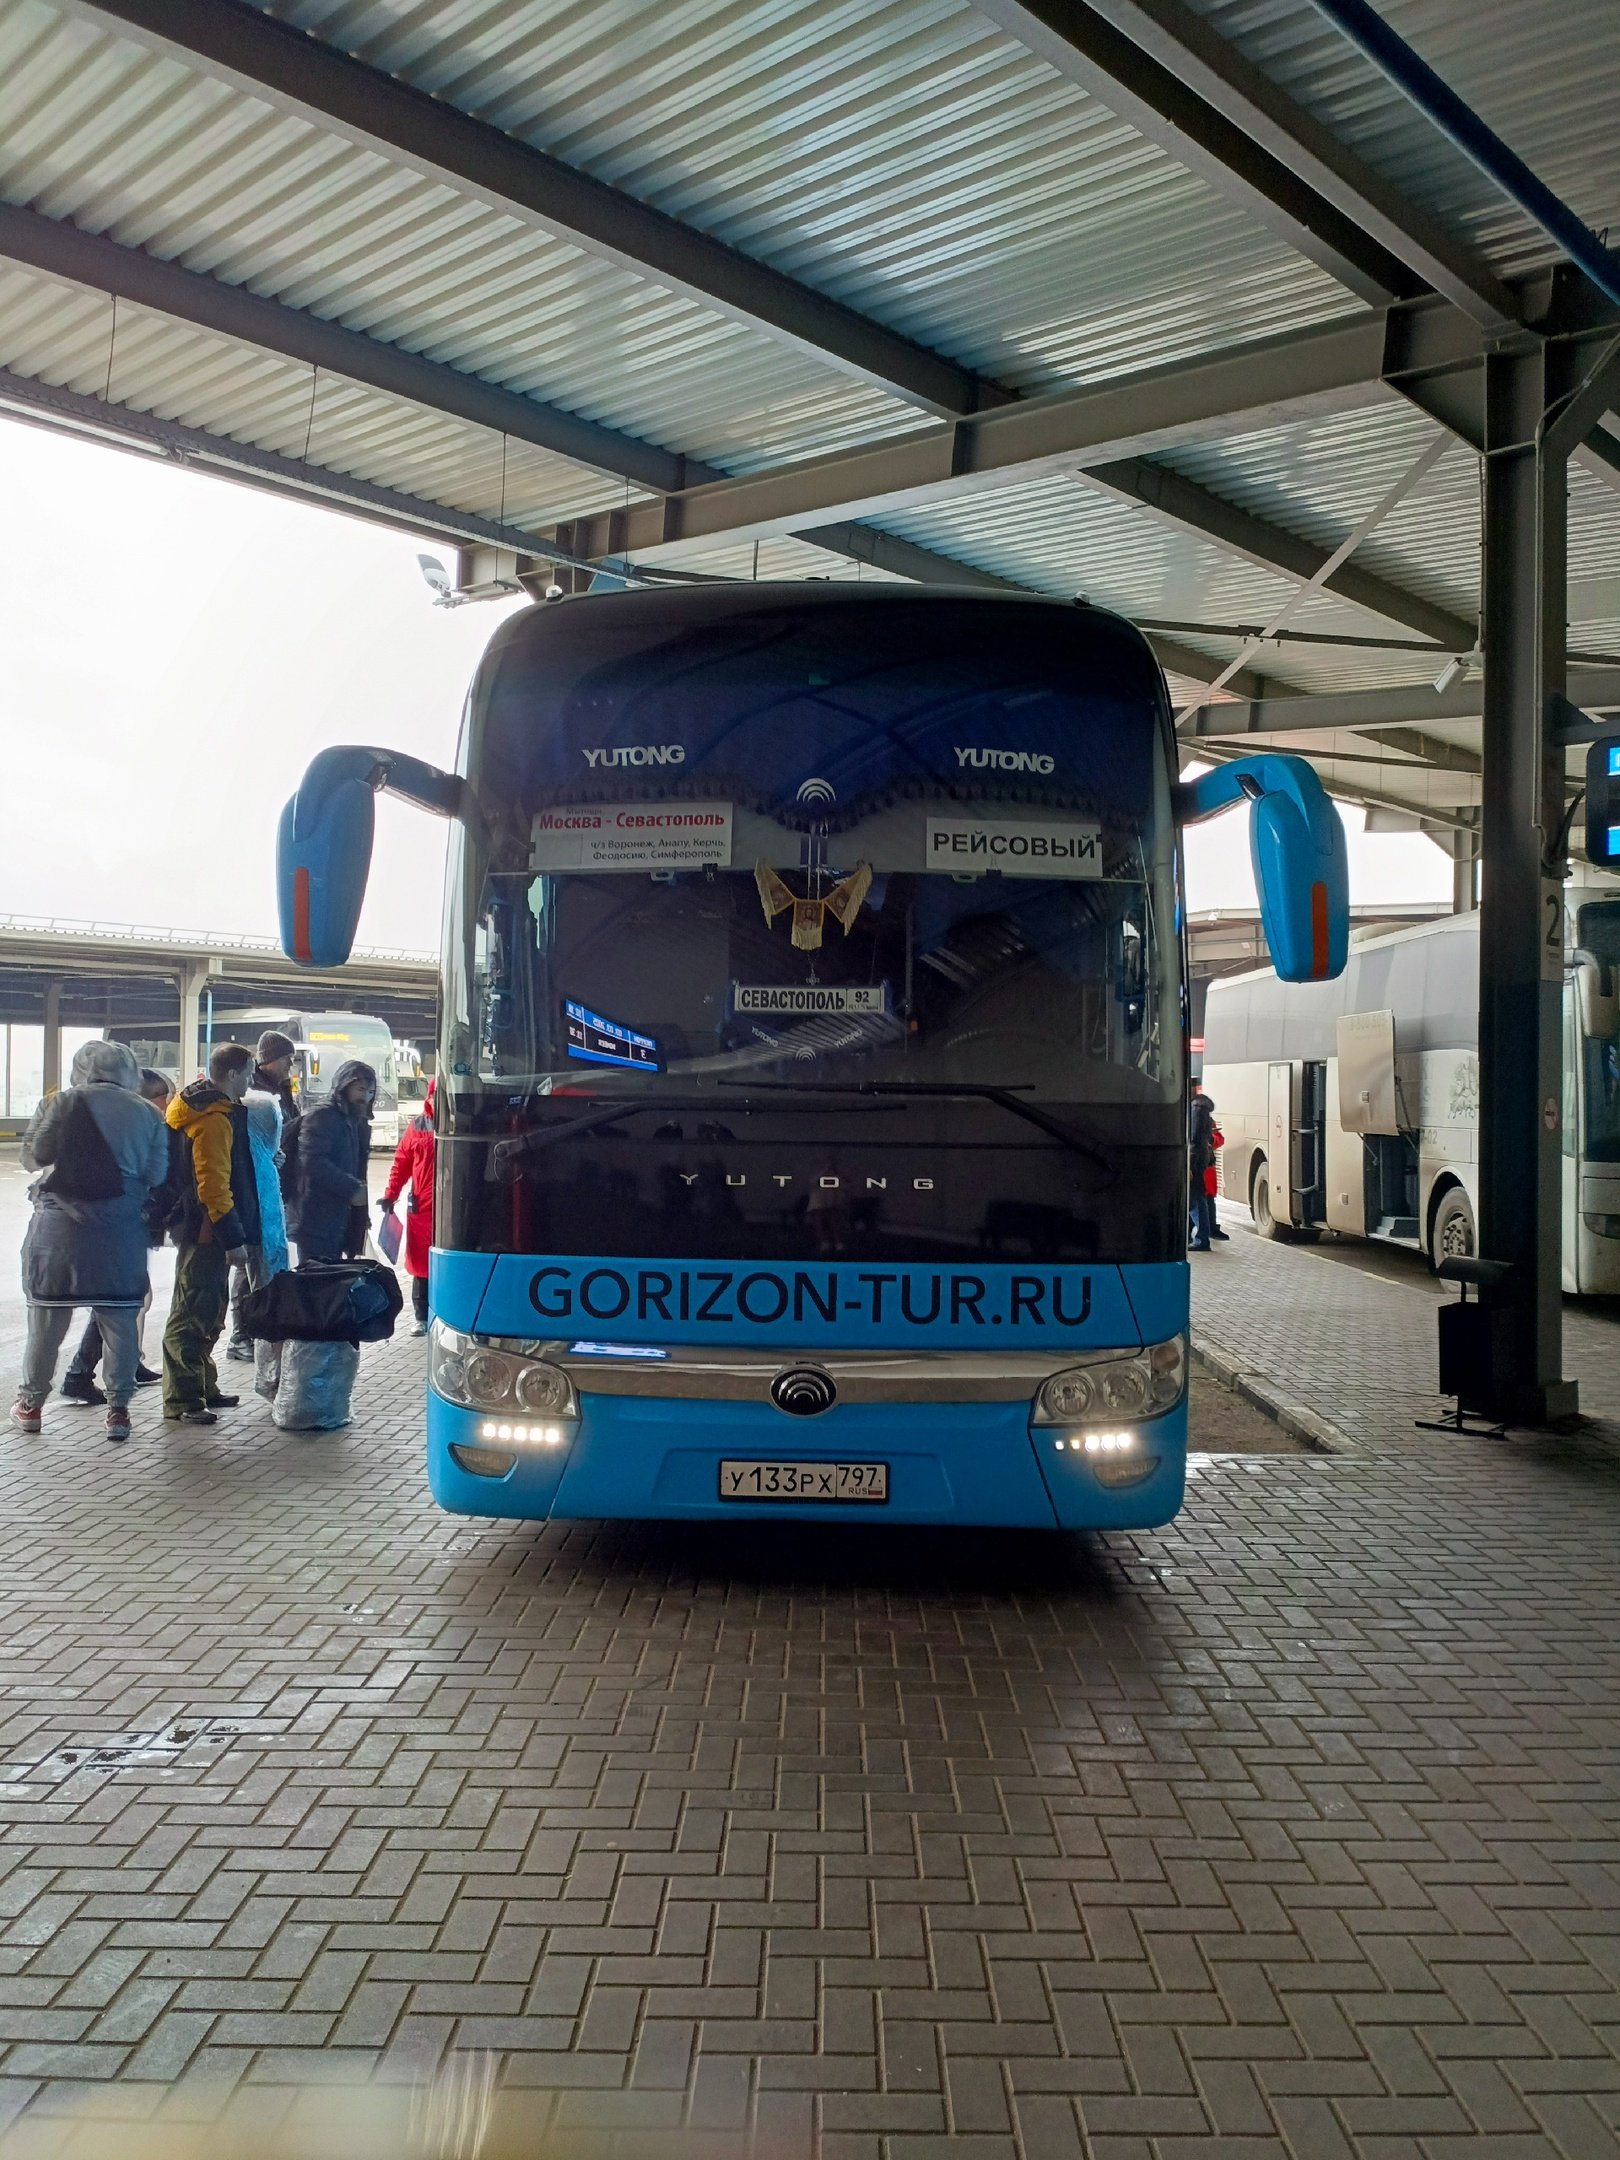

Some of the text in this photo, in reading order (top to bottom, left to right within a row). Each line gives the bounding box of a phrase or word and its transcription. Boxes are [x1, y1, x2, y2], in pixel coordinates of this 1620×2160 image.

[582, 745, 686, 768] YUTONG
[953, 746, 1055, 775] YUTONG
[539, 813, 602, 831] Москва
[616, 811, 725, 829] Севастополь
[608, 840, 655, 851] Воронеж,
[658, 839, 690, 850] Анапу,
[933, 829, 1096, 859] РЕЙСОВЫЙ
[593, 849, 723, 861] Феодосию, Симферополь
[1546, 894, 1561, 947] 2
[741, 989, 846, 1011] СЕВАСТОПОЛЬ
[855, 990, 870, 1003] 92
[679, 1173, 934, 1190] YUTONG
[528, 1265, 1093, 1327] GORIZON-TUR.RU
[838, 1467, 878, 1487] 797
[848, 1487, 868, 1496] RUS
